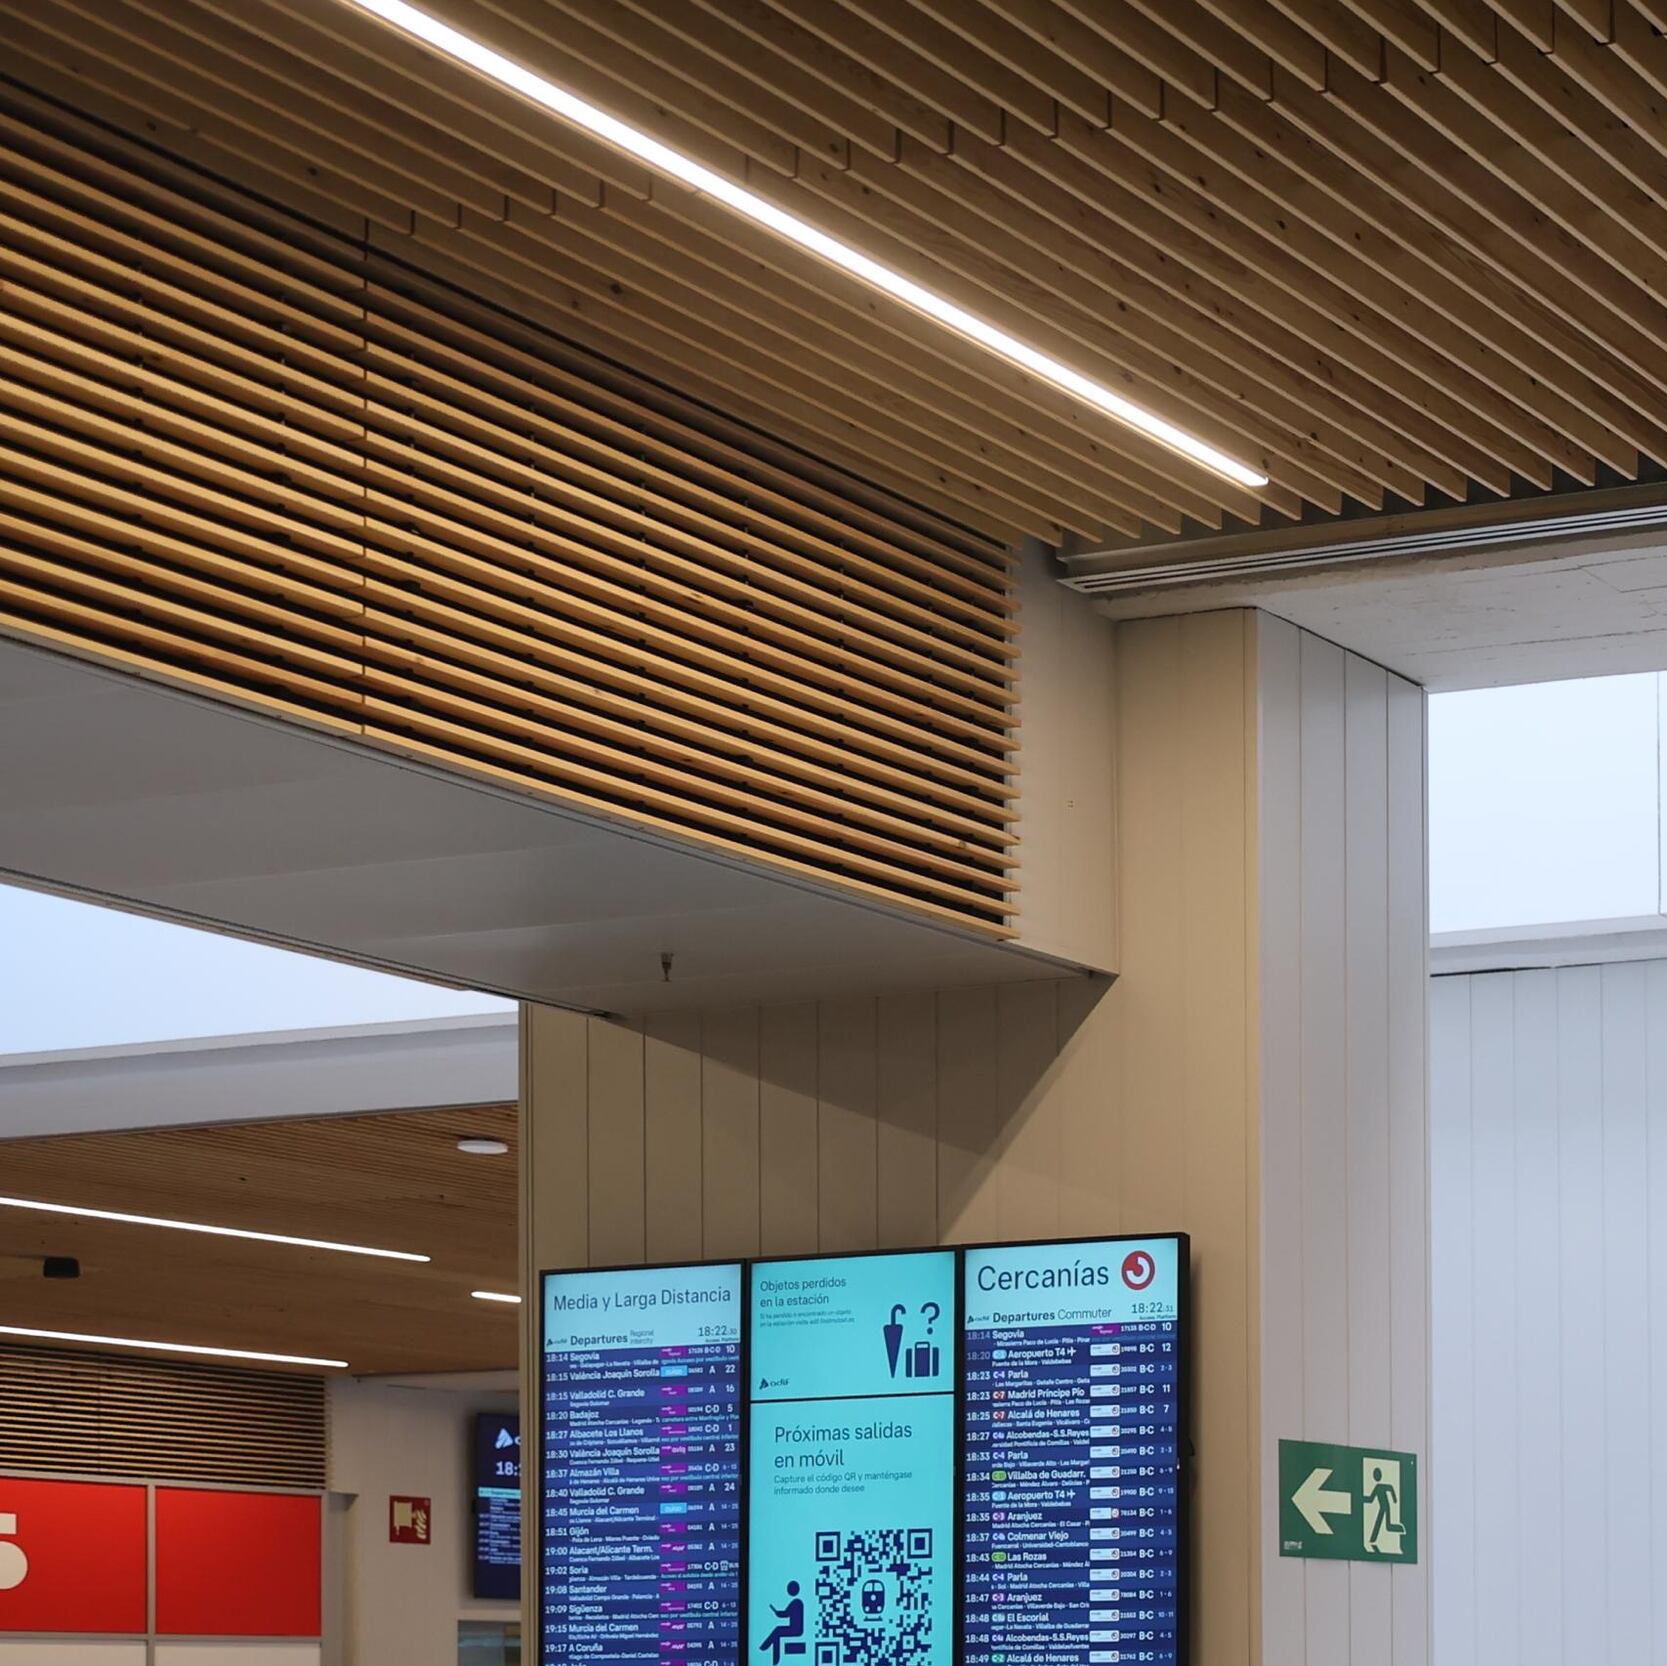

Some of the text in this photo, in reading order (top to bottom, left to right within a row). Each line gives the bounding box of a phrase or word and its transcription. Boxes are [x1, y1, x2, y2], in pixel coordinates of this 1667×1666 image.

[978, 1259, 1109, 1292] Cercanías
[760, 1277, 846, 1293] Objetos perdidos
[554, 1286, 731, 1311] Media y Larga Distancia
[760, 1293, 829, 1308] en la estación
[992, 1311, 1055, 1324] Departures
[1057, 1307, 1112, 1321] Commuter
[570, 1335, 628, 1347] Departures
[966, 1329, 1025, 1341] 18:14 Segovia
[546, 1352, 600, 1364] 18:14 Segovia
[966, 1347, 1066, 1361] 18:20 Aeropuerto T4
[546, 1368, 660, 1382] 18:15 Joaquín Sorolla
[966, 1369, 1029, 1381] 18:23 Parla
[546, 1389, 645, 1401] 18:15 Valladolid Grande
[966, 1387, 1085, 1400] 18:23 Madrid Príncipe Pío
[546, 1410, 599, 1421] 18:20 Badajoz
[966, 1408, 1080, 1421] 18:25 Alcalá de Henares
[546, 1428, 643, 1439] 18:27 Albacete Los Llanos
[775, 1422, 912, 1443] Próximas salidas
[966, 1431, 990, 1441] 18:27
[546, 1446, 660, 1459] 18:30 Joaquín Sorolla
[774, 1449, 844, 1468] en móvil
[966, 1451, 1028, 1461] 18:33 Parla
[496, 1460, 521, 1476] 18:
[546, 1467, 619, 1478] 18:37 Almazán Villa
[774, 1471, 912, 1485] Capture el código QR y manténgase
[966, 1470, 1086, 1481] 18:34 Villalba de Guadarr.
[546, 1486, 645, 1498] 18:40 Valladolid Grande
[774, 1484, 864, 1496] informado donde desee
[966, 1490, 1065, 1502] 18:35 Aeropuerto T4
[546, 1506, 639, 1517] 18:45 Murcia del Carmen
[966, 1511, 1043, 1522] 18:35 Aranjuez
[545, 1527, 589, 1537] 18:51 Gijón
[966, 1531, 1069, 1542] 18:37 Colmenar Viejo
[545, 1546, 568, 1555] 19:00
[965, 1552, 1047, 1563] 18:43 Las Rozas
[545, 1566, 589, 1575] 19:02 Soria
[965, 1572, 1028, 1583] 18:44 Parla
[545, 1585, 607, 1594] 19:08 Santander
[965, 1593, 1042, 1604] 18:47 Aranjuez
[545, 1605, 567, 1614] 19:09
[965, 1612, 1049, 1623] 18:48 El Escorial
[545, 1623, 639, 1633] 19:15 Murcia del Carmen
[965, 1632, 1089, 1644] 18:48 Alcobendas-S.S.Reyes
[545, 1642, 603, 1653] 19:17 A Coruña
[965, 1652, 1079, 1664] 18:49 Alcalá de Henares
